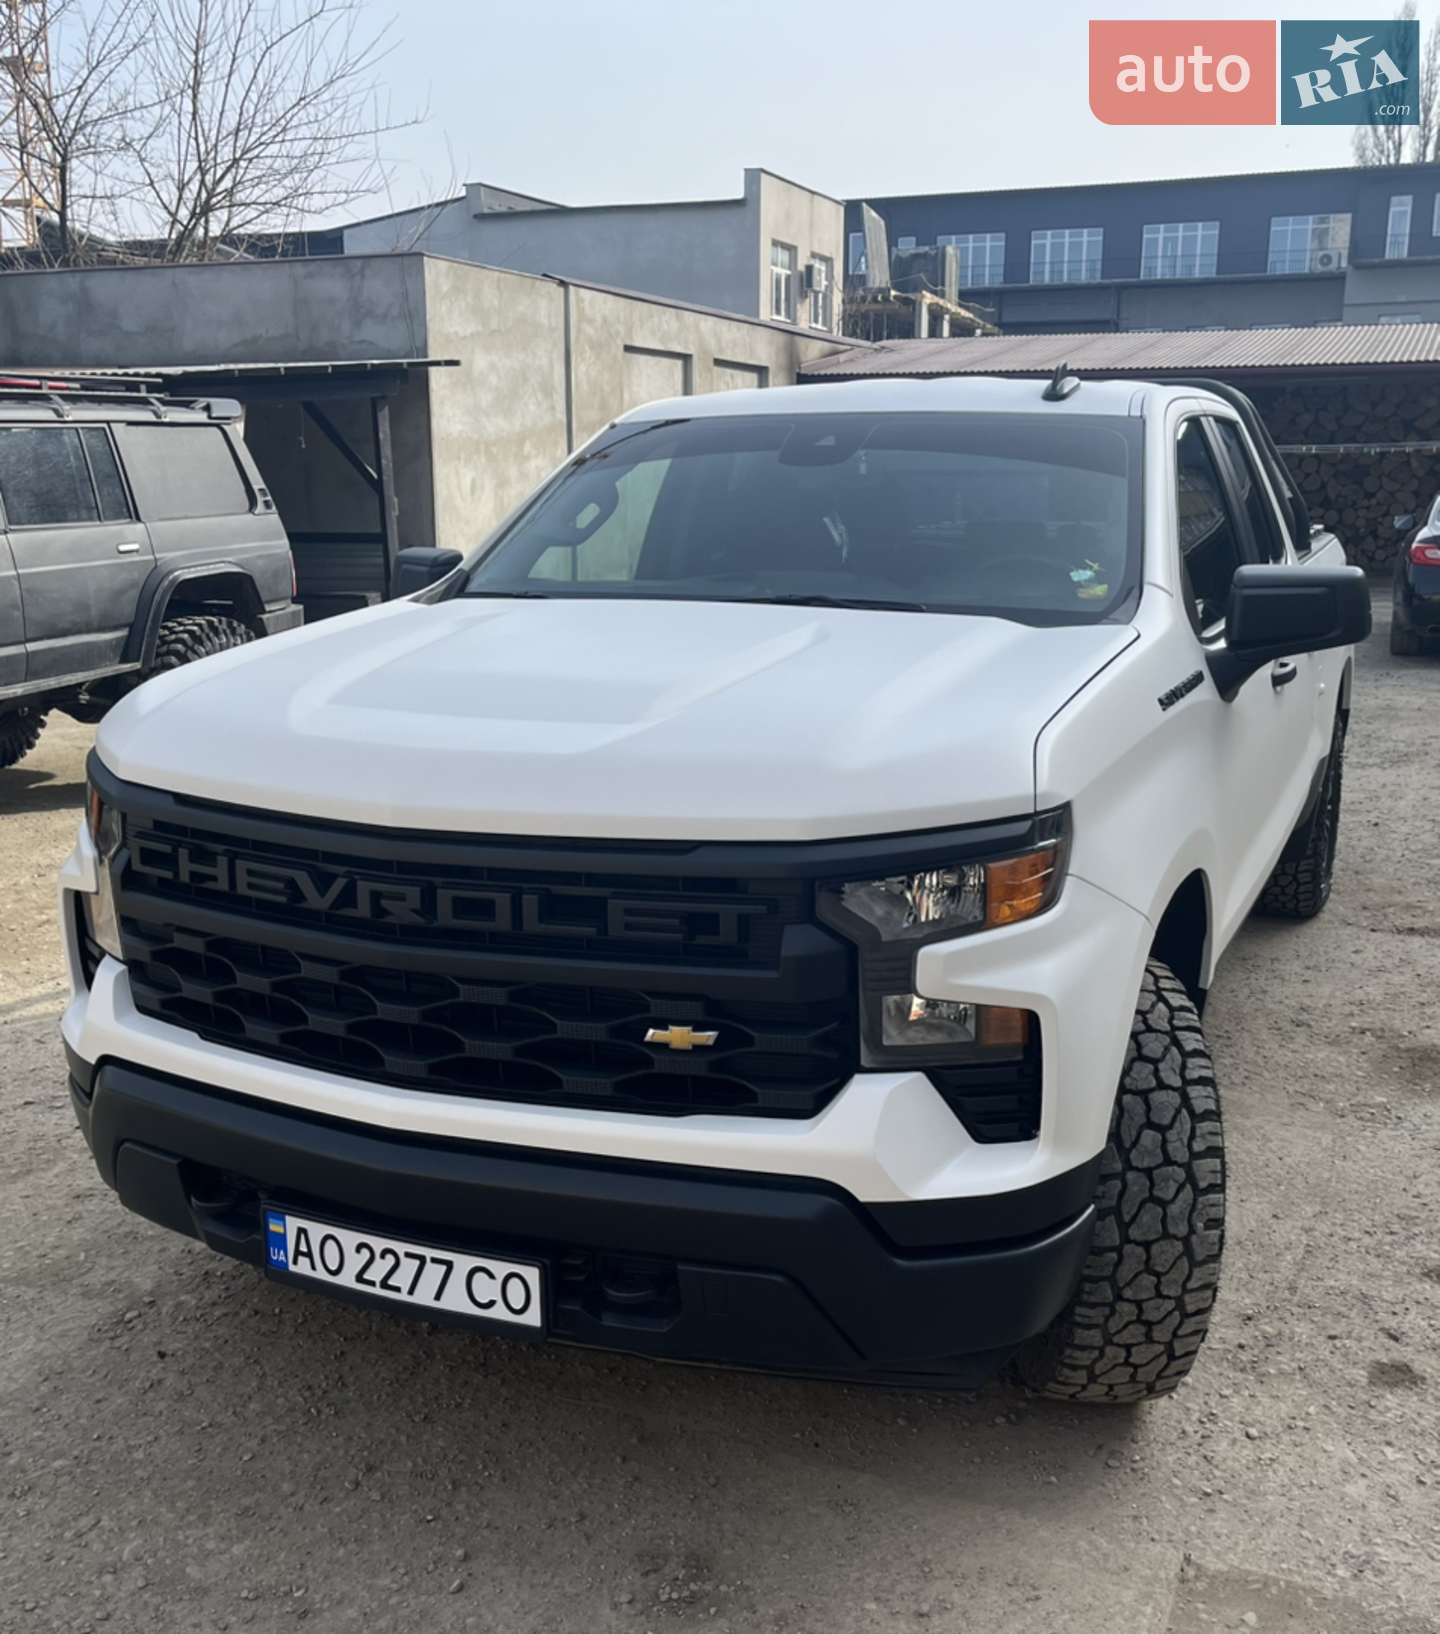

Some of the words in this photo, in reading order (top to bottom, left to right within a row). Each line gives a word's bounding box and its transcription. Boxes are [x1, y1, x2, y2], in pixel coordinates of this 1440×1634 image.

[129, 836, 770, 945] CHEVROLET
[270, 1247, 287, 1263] UA
[292, 1226, 345, 1276] AO
[354, 1242, 454, 1301] 2277
[465, 1265, 531, 1315] CO
